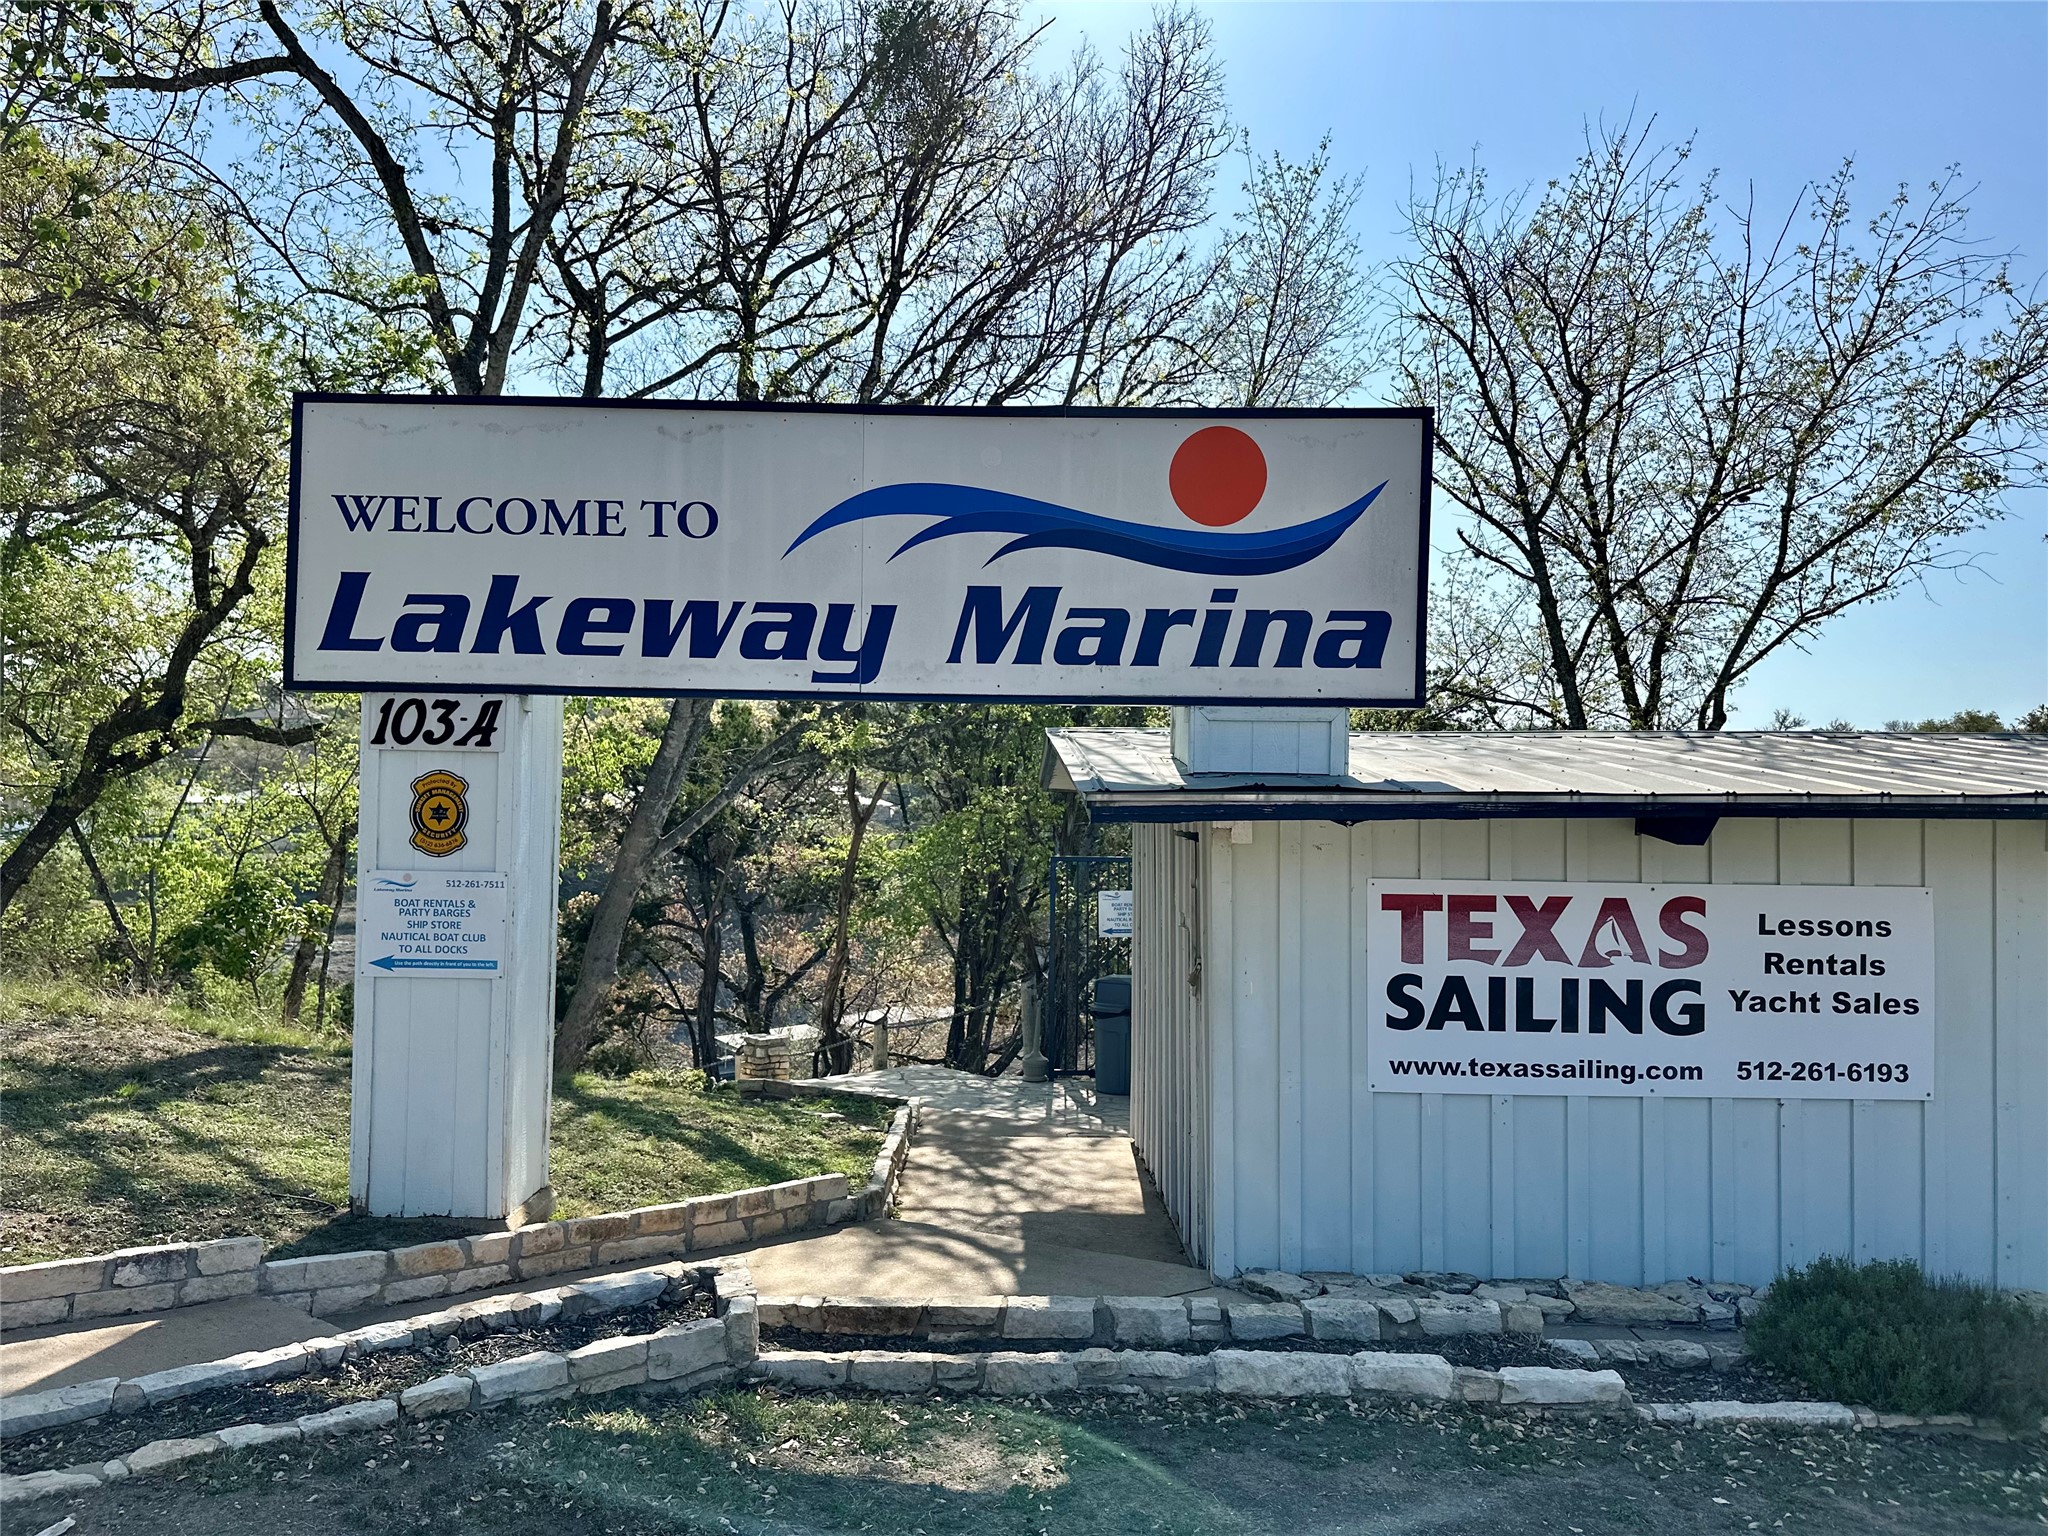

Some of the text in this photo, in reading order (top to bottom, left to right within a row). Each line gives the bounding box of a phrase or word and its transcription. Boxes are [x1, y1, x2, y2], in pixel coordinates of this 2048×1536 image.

[331, 494, 719, 539] WELCOME TO
[316, 571, 1393, 685] Lakeway Marina
[370, 697, 503, 747] 103-A
[422, 779, 450, 789] Protected
[415, 788, 464, 813] SUNSET MANAGEMENT
[422, 827, 457, 839] SECURITY
[445, 879, 505, 889] 512-261-7511
[394, 898, 476, 909] BOAT RENTALS &
[399, 908, 471, 918] PARTY BARGES
[407, 920, 462, 930] SHIP STORE
[1381, 893, 1710, 970] TEXAS
[1758, 913, 1892, 938] Lessons
[381, 932, 487, 943] NAUTICAL BOAT CLUB
[398, 945, 468, 955] TO ALL DOCKS
[1764, 952, 1886, 976] Rentals
[1385, 972, 1706, 1037] SAILING
[1728, 989, 1920, 1015] Yacht Sales
[1388, 1058, 1703, 1085] www.texassailing.com
[1736, 1061, 1909, 1083] 512-261-6193
